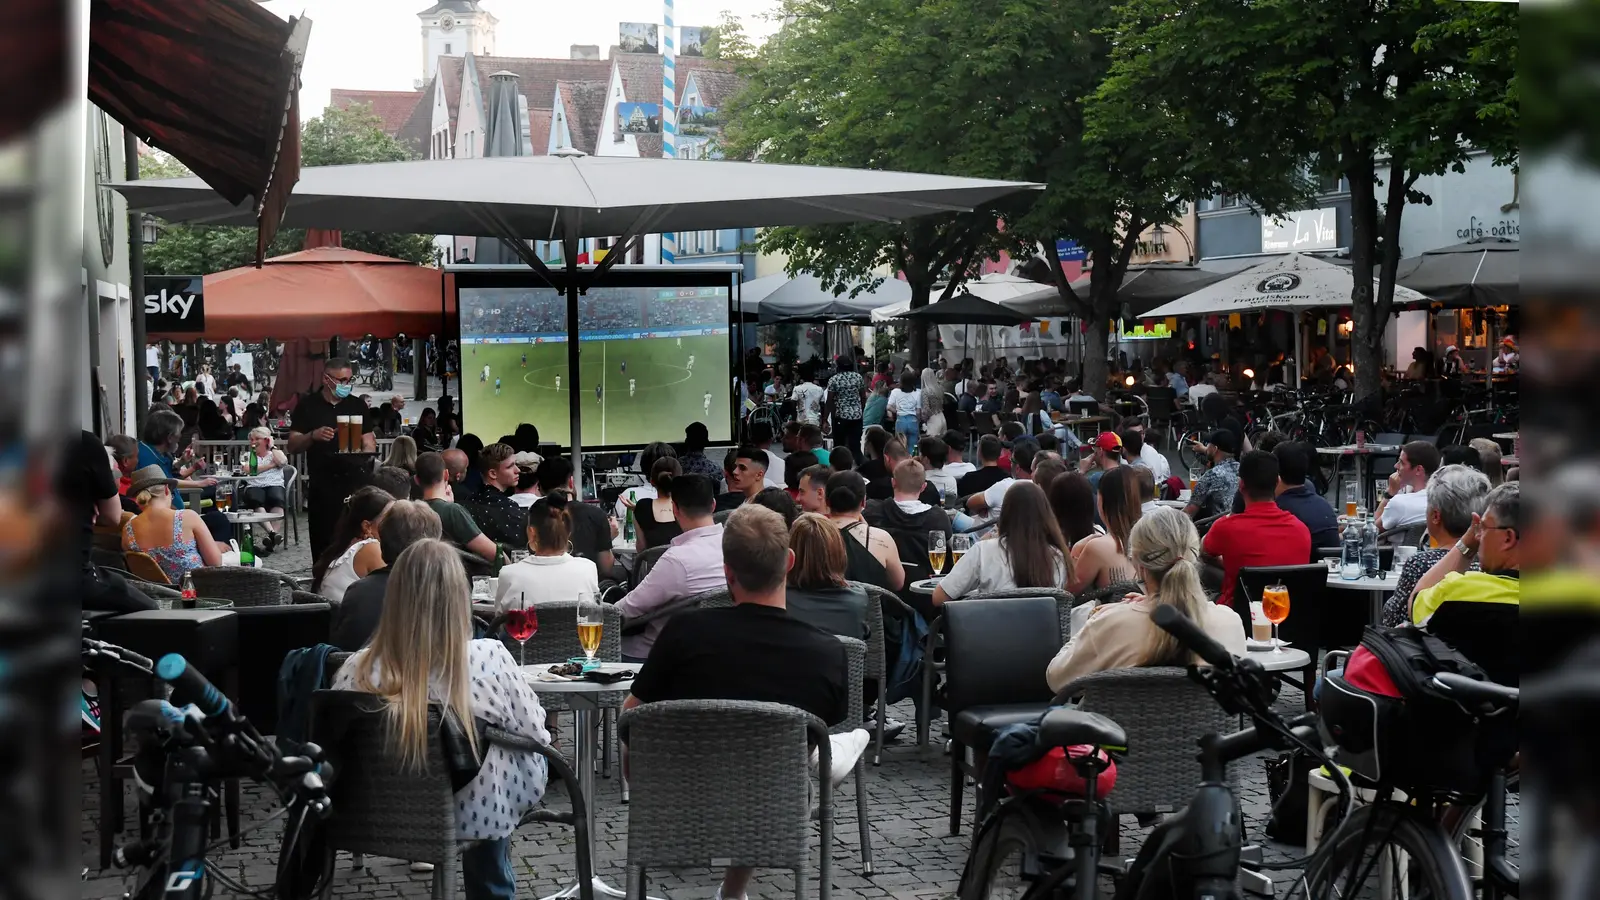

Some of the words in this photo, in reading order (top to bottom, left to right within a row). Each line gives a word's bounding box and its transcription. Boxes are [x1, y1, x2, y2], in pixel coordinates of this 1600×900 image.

[1292, 216, 1309, 247] La
[1313, 212, 1334, 244] Vita
[1456, 215, 1483, 239] café
[144, 288, 196, 319] sky
[1233, 294, 1310, 304] Franziskaner
